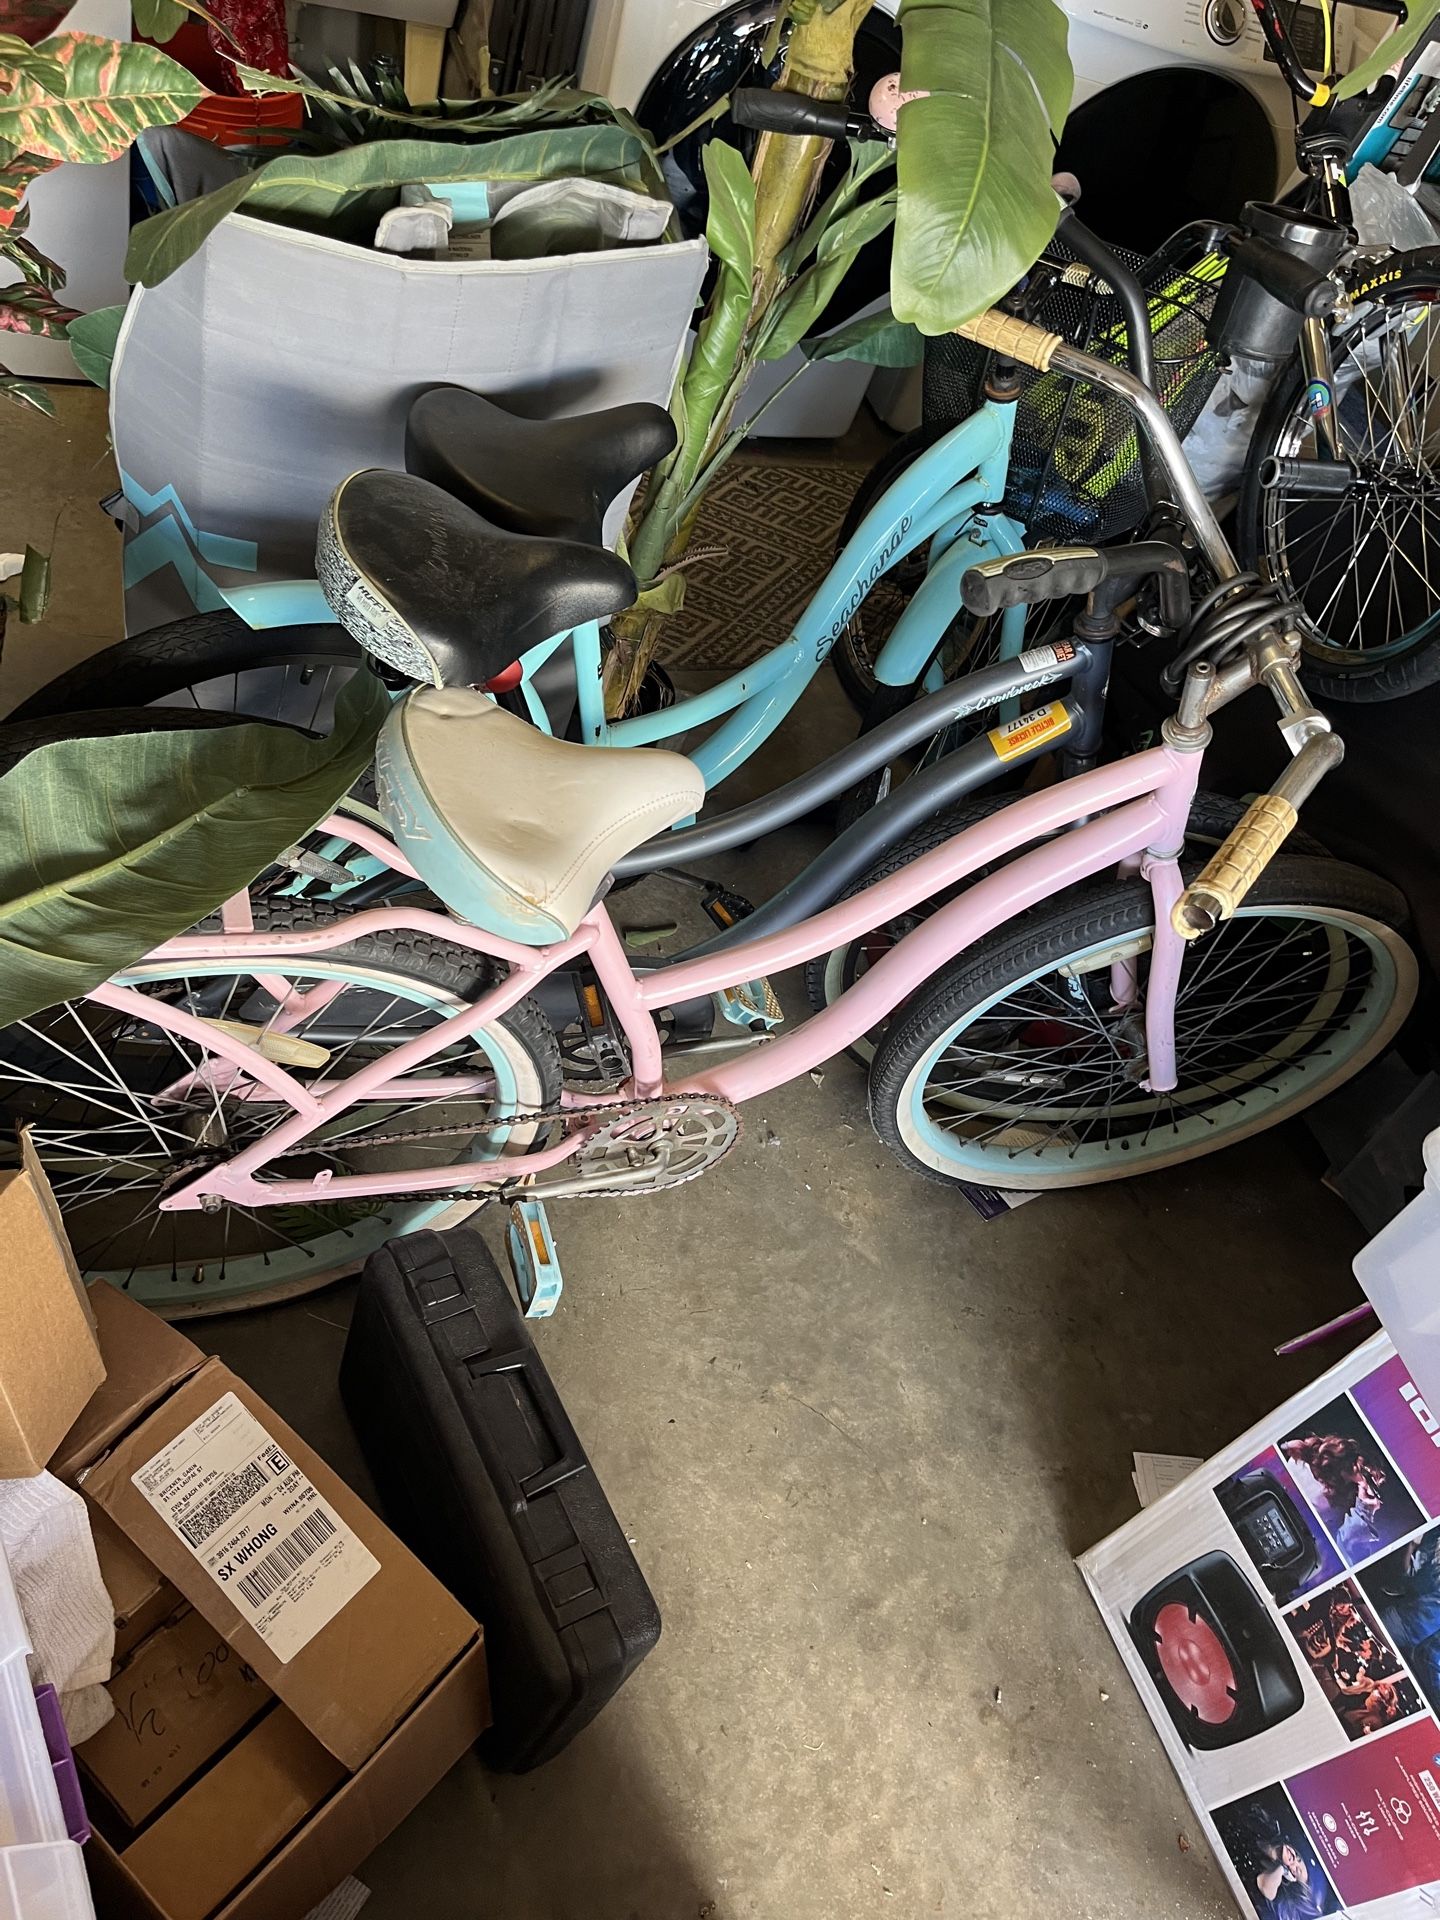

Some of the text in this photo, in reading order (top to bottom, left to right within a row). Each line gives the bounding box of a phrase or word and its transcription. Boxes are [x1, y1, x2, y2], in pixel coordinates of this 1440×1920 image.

[1349, 268, 1402, 301] MAXXIS
[358, 585, 391, 614] HUFFY
[1052, 643, 1066, 662] ELMET
[1007, 708, 1046, 734] D 34177
[1008, 717, 1055, 746] BICYCLE LICENSE
[1398, 1381, 1440, 1448] IO
[257, 1443, 276, 1461] FedEx
[283, 1475, 294, 1487] AUG
[182, 1487, 198, 1502] BEACH
[306, 1491, 317, 1502] HNL
[217, 1523, 278, 1582] SX WHONG
[1424, 1777, 1434, 1791] 250
